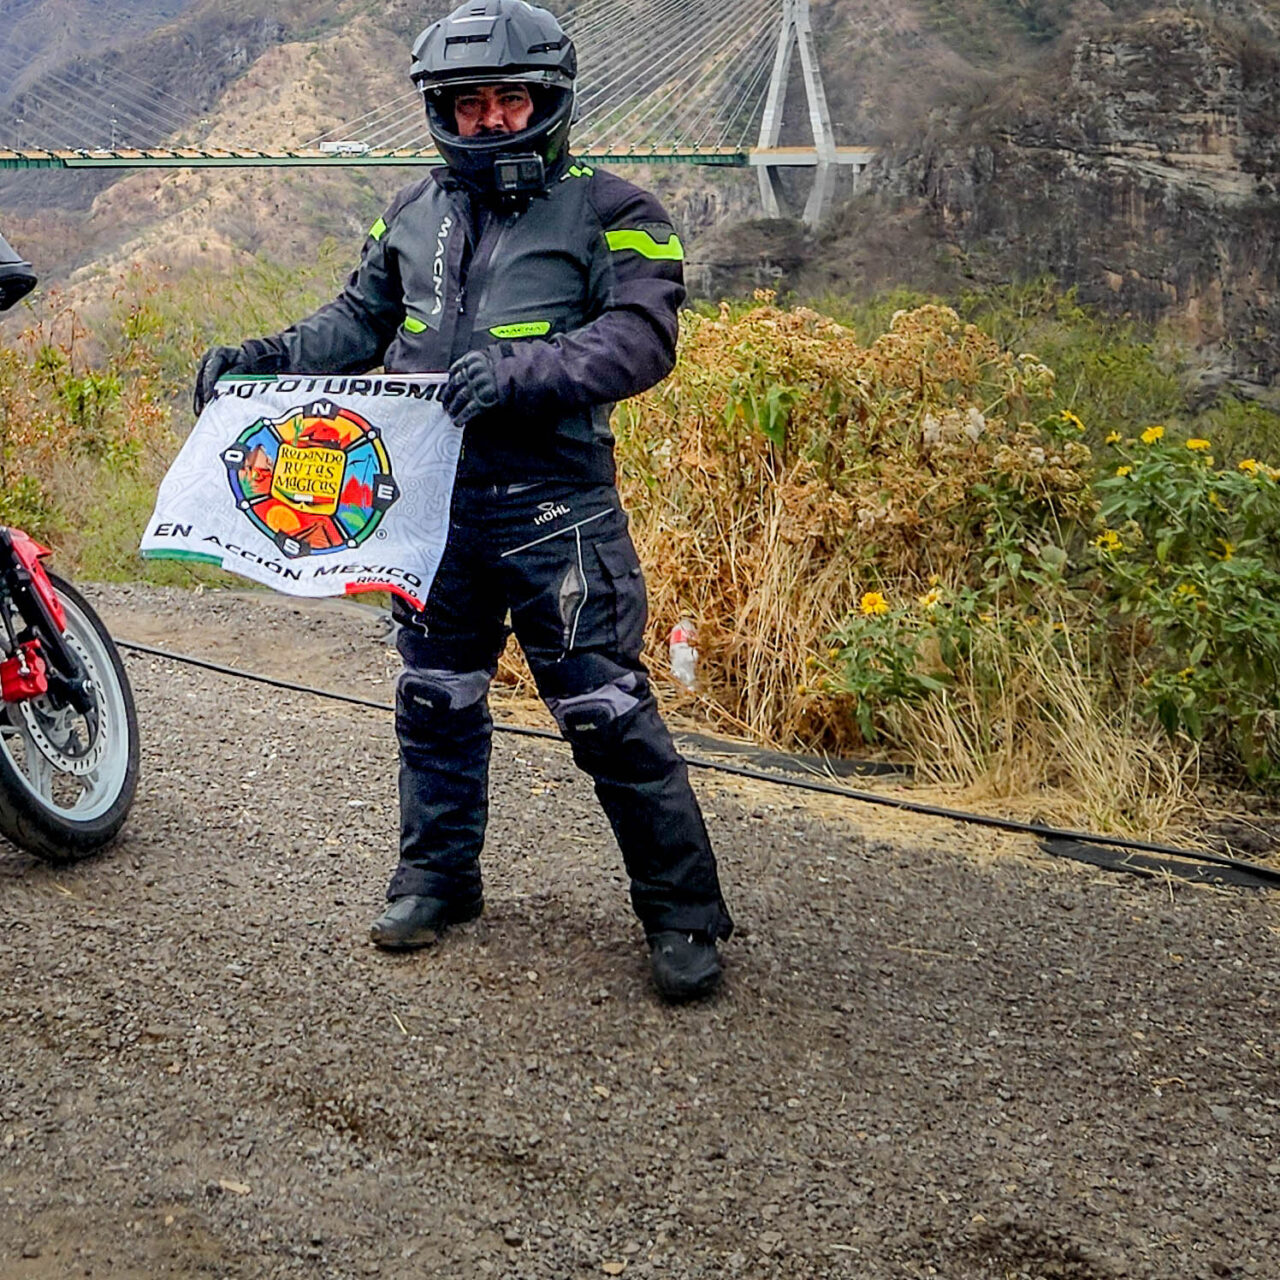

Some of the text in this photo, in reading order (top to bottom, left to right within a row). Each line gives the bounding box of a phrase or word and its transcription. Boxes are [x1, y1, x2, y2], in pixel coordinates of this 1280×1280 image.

[431, 216, 452, 315] MACNA
[311, 403, 332, 416] N
[376, 485, 394, 500] E
[153, 523, 192, 537] EN
[202, 535, 303, 581] ACCIÓN
[283, 537, 301, 553] S
